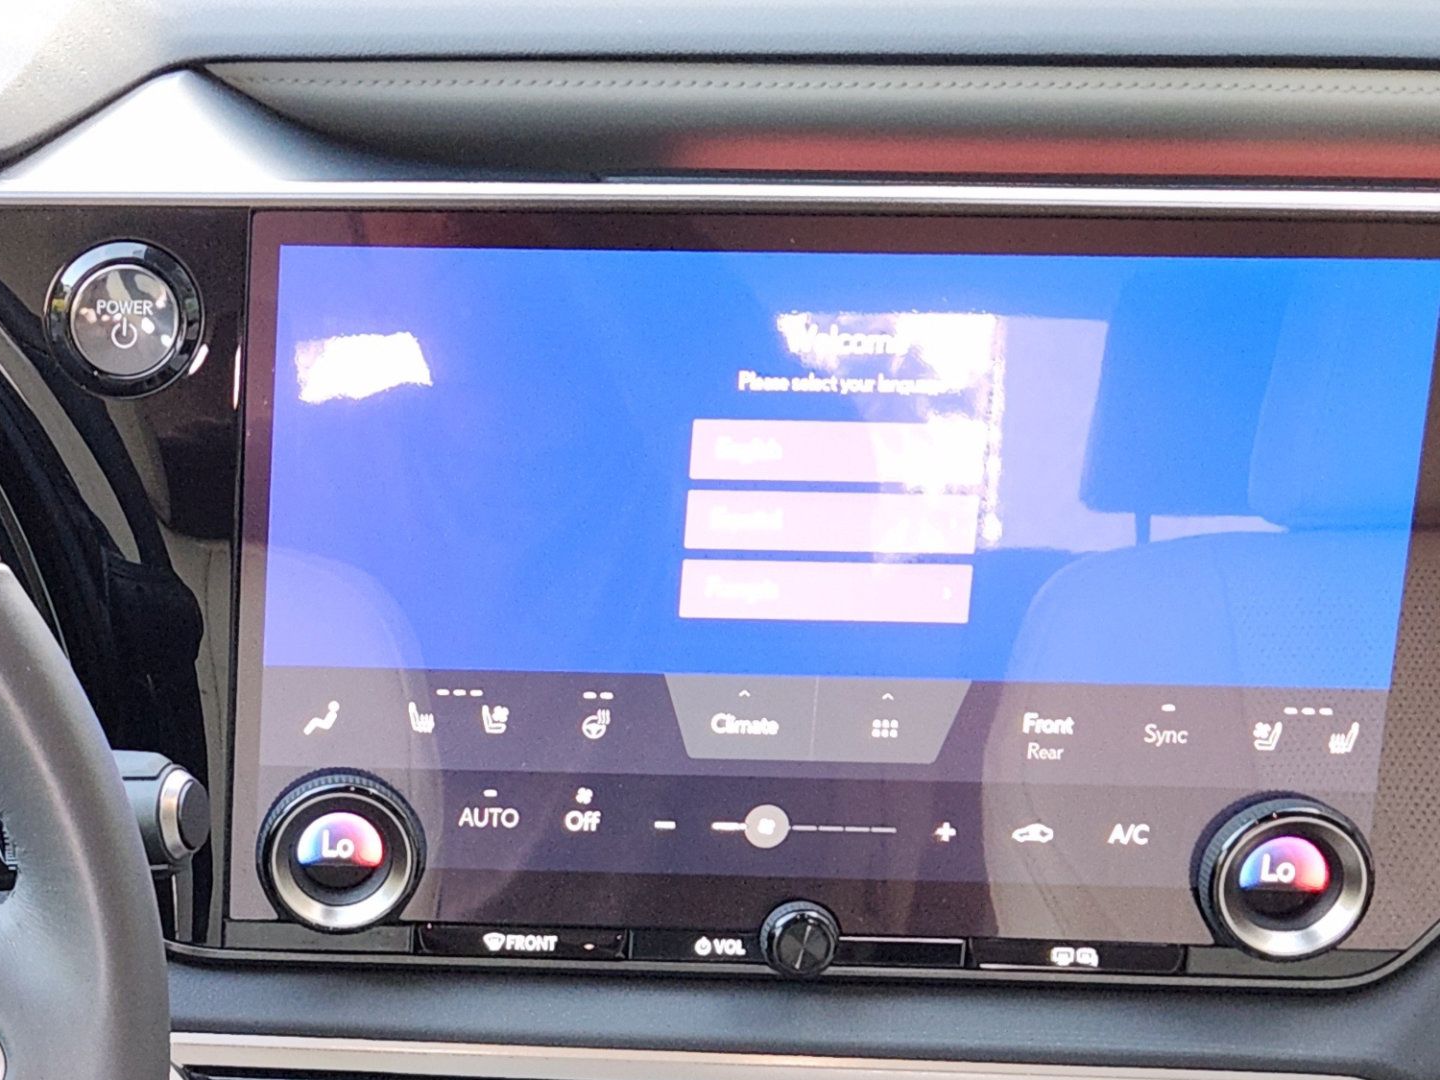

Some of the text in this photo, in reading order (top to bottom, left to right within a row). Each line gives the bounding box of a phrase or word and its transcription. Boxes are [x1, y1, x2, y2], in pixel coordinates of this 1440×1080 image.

[96, 299, 154, 315] POWER
[738, 370, 789, 391] Please
[791, 371, 839, 393] select
[840, 378, 876, 394] your
[711, 713, 779, 736] Climate
[1022, 711, 1075, 737] Front
[1143, 723, 1189, 747] Sync
[1026, 743, 1064, 762] Rear
[458, 808, 520, 829] AUTO
[564, 810, 601, 833] Off
[321, 830, 355, 859] Lo
[1107, 823, 1150, 847] A/C
[1260, 853, 1297, 884] Lo
[505, 935, 558, 953] FRONT
[712, 938, 746, 956] VOL
